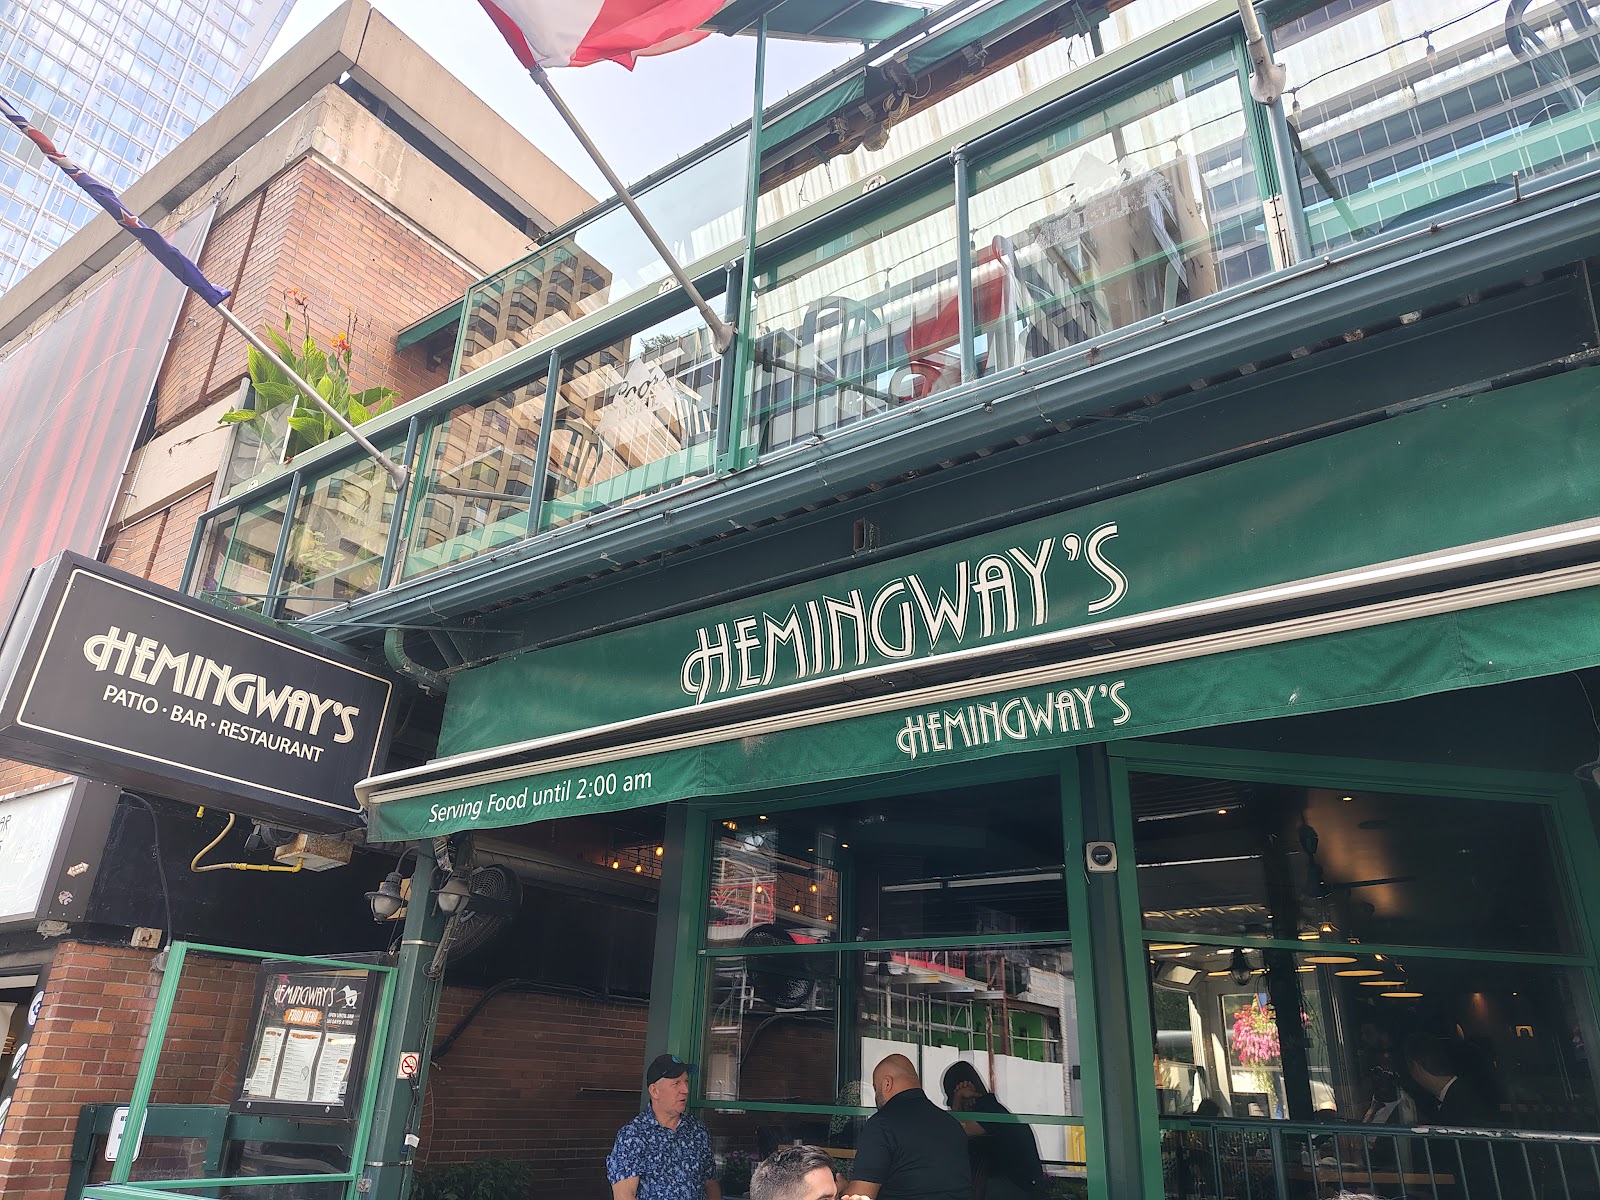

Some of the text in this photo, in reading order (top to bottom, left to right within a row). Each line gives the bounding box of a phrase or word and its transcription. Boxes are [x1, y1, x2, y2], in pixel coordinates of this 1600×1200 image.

[680, 521, 1129, 705] HEMINGWAY'S
[82, 625, 360, 744] HEMINGWAY'S
[102, 684, 325, 763] PATIO BAR RESTAURANT
[896, 680, 1132, 760] HEMINGWAY'S
[428, 772, 652, 823] Serving Food until 2:00 am
[288, 1009, 304, 1022] FOOD
[302, 1011, 319, 1023] MENU
